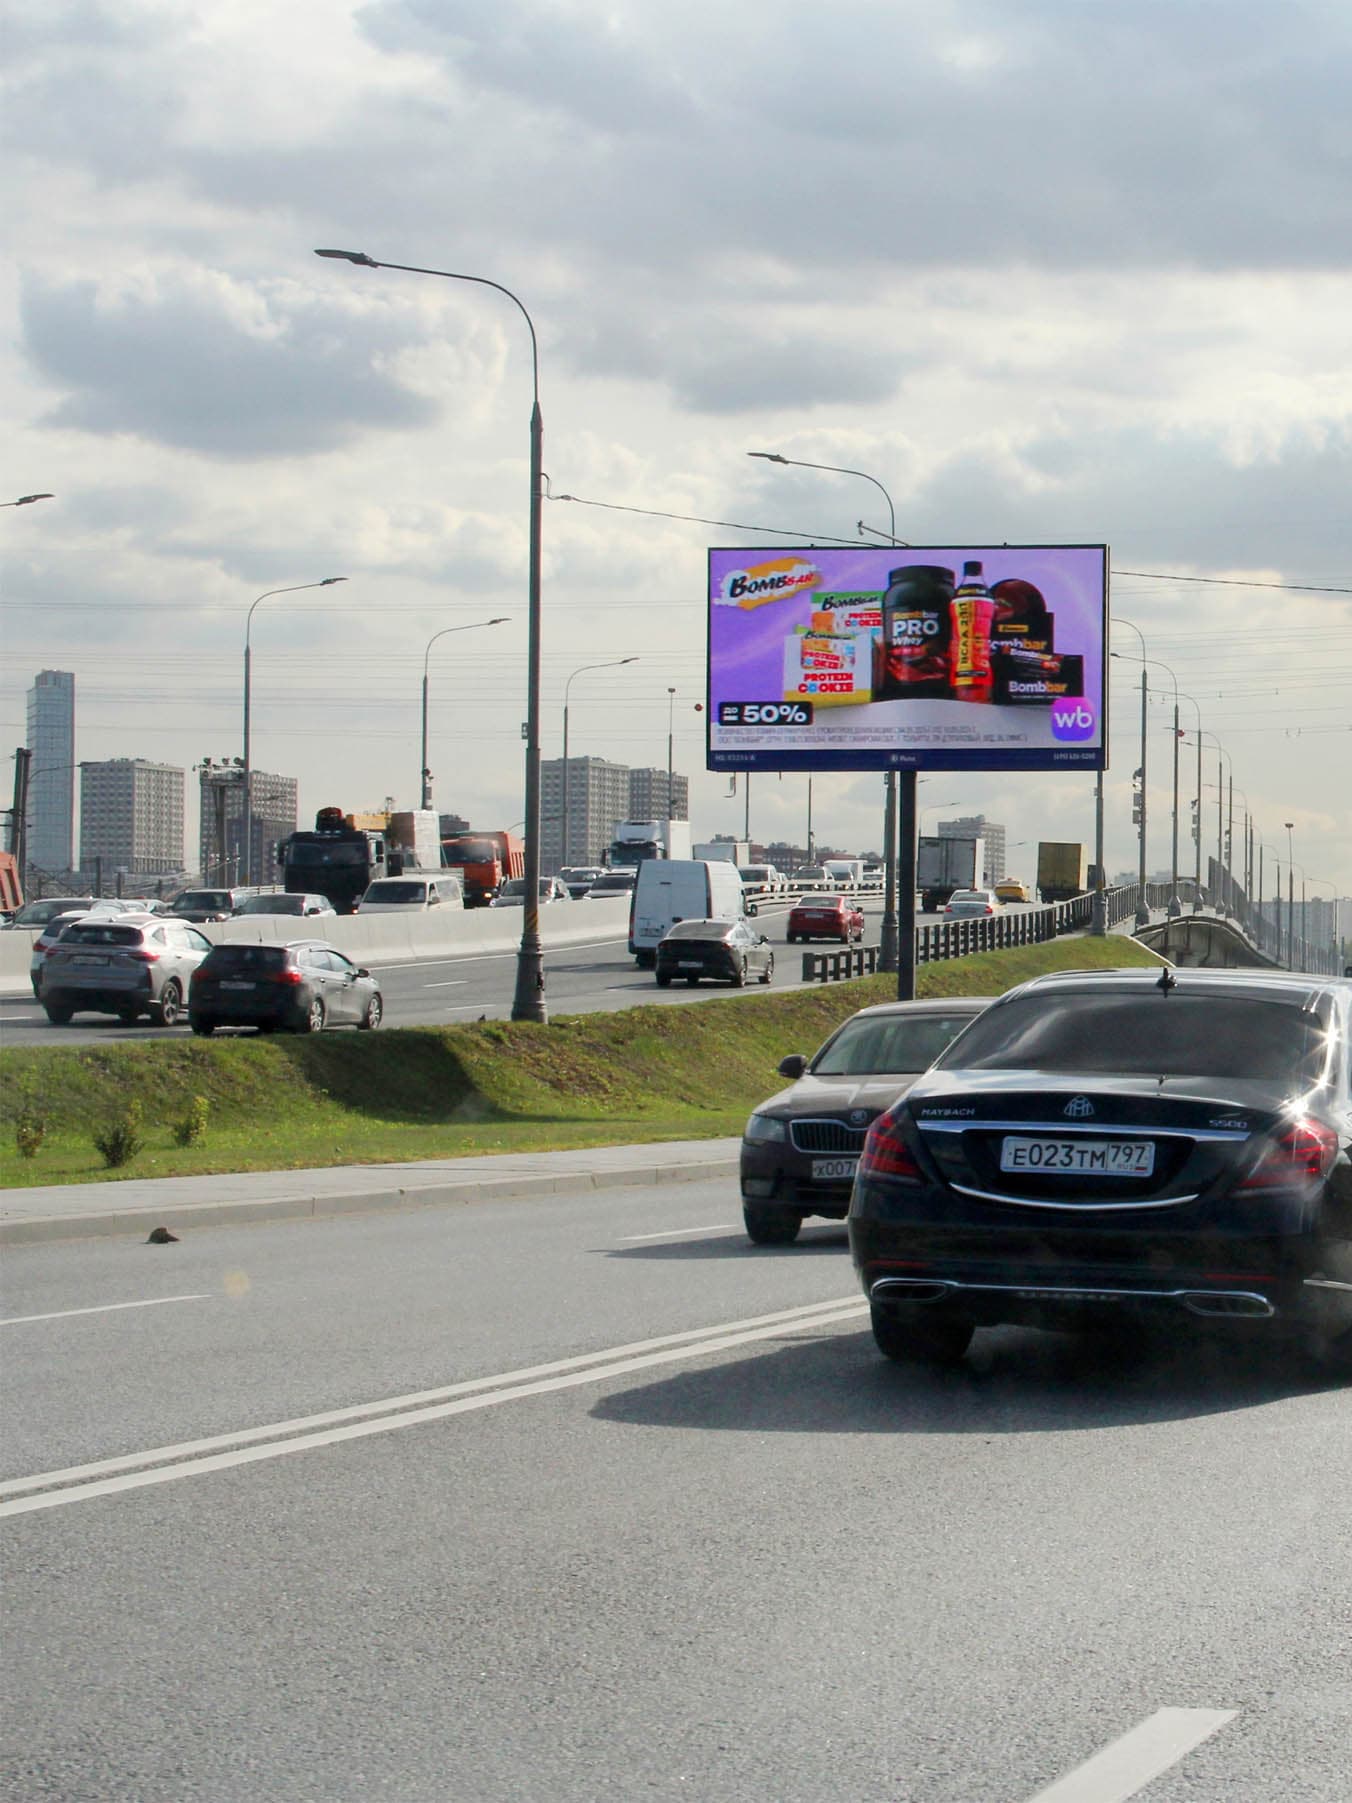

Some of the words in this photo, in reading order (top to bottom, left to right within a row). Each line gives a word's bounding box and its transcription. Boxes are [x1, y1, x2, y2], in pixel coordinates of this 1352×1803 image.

[892, 620, 939, 637] PRO
[803, 672, 854, 682] PROTEIN
[798, 682, 854, 693] COOKIE
[1008, 681, 1068, 693] Bombbar
[1054, 705, 1093, 729] wb
[920, 1108, 976, 1117] MAYBACH
[1110, 1144, 1147, 1163] 797
[815, 1160, 857, 1177] Х007
